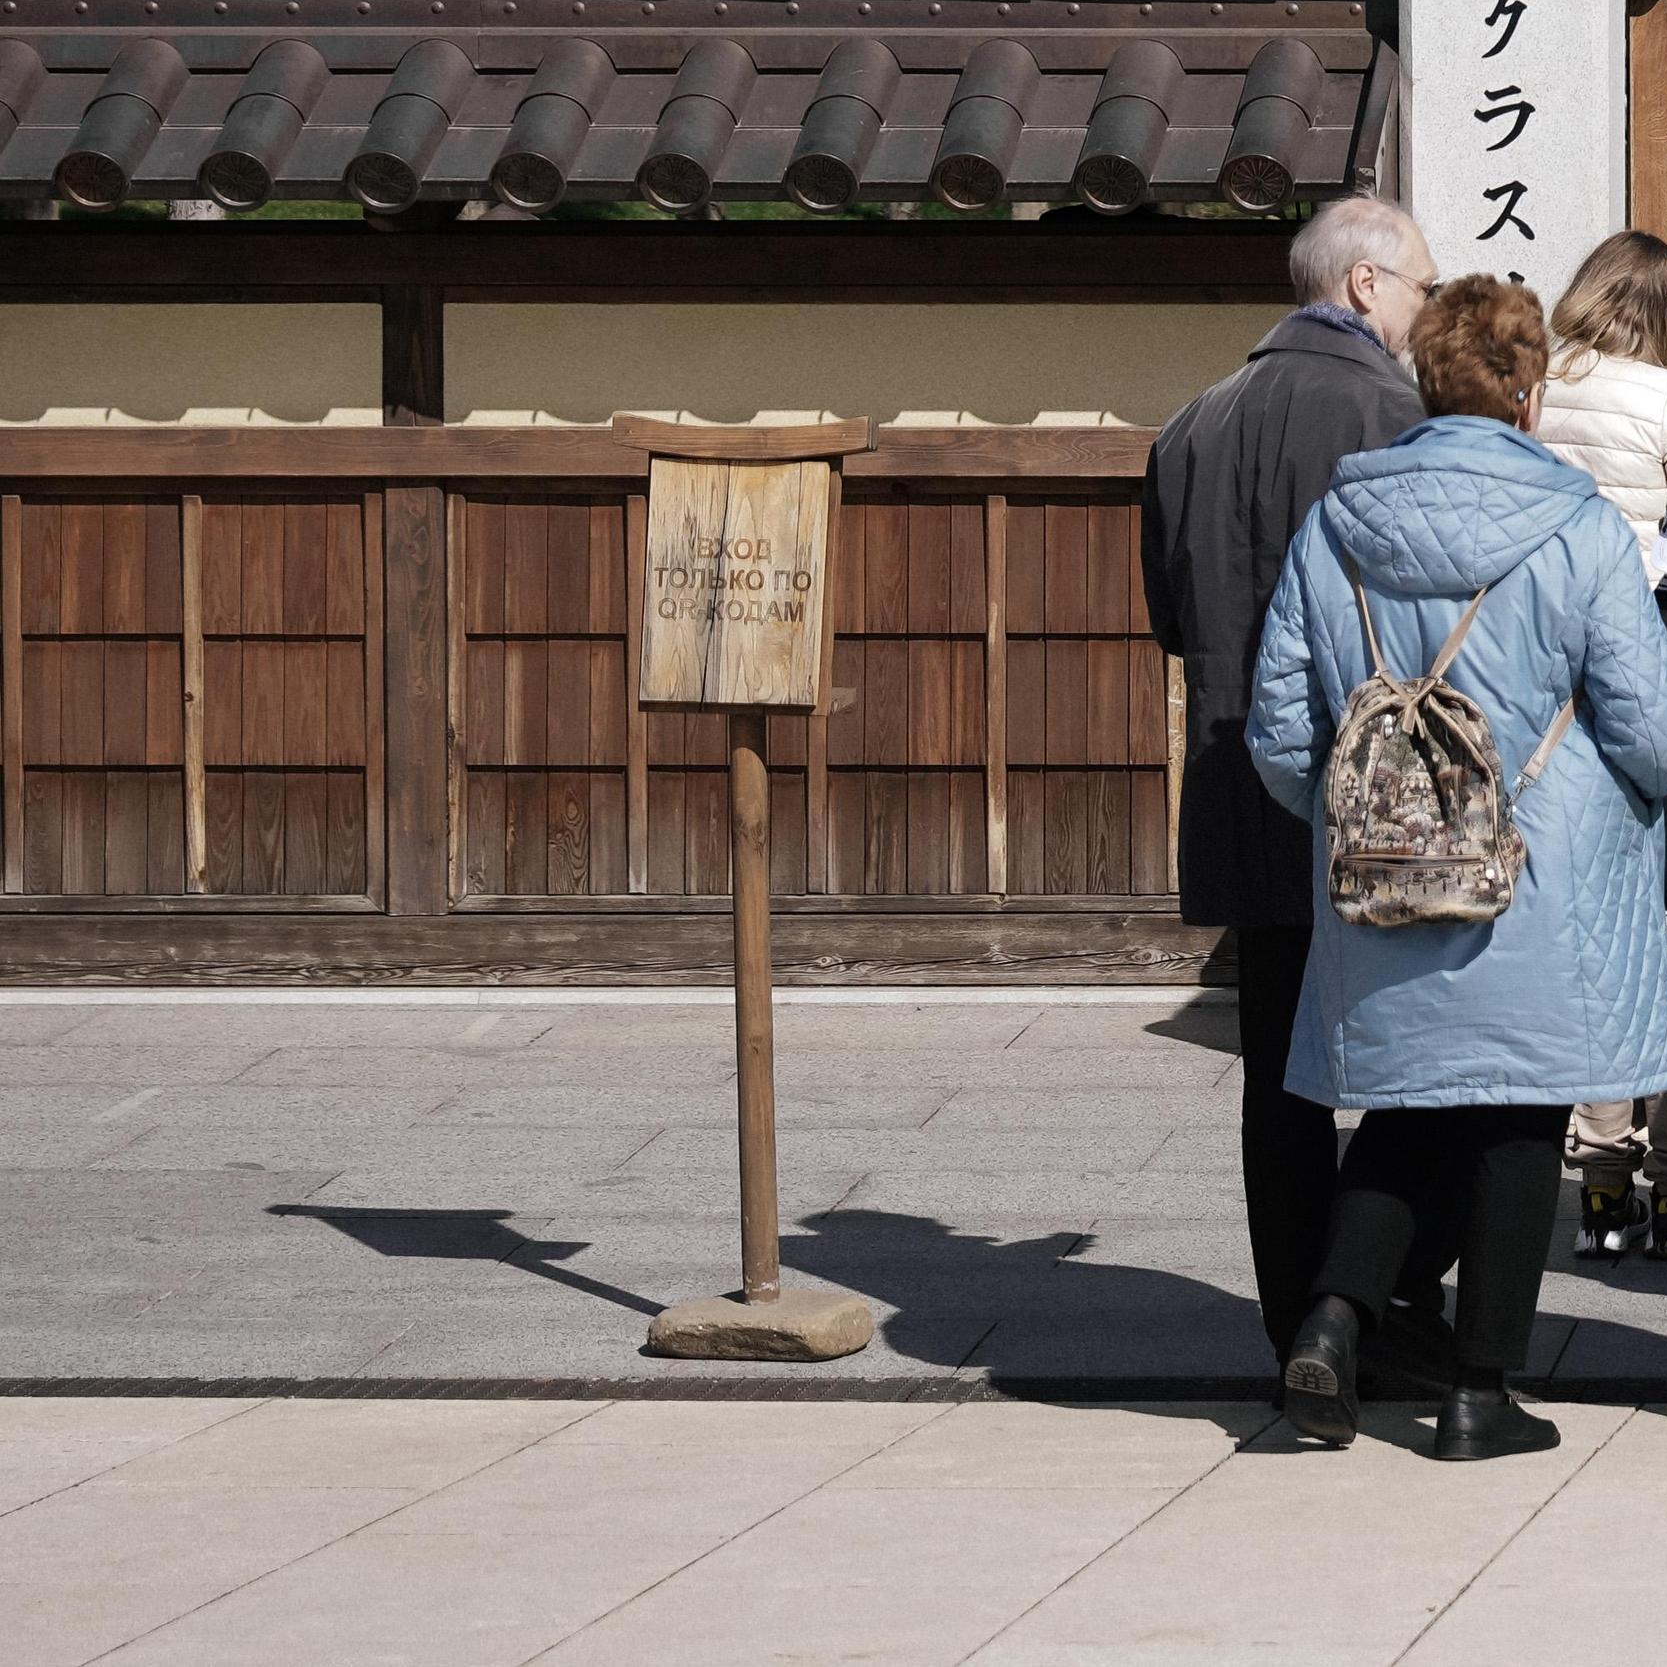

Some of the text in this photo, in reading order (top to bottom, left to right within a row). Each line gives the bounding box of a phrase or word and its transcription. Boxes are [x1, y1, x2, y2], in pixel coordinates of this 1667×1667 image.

[698, 538, 772, 564] ВХОД
[654, 567, 812, 592] ТОЛЬКО ПО
[657, 597, 804, 626] QR-КОДАМ
